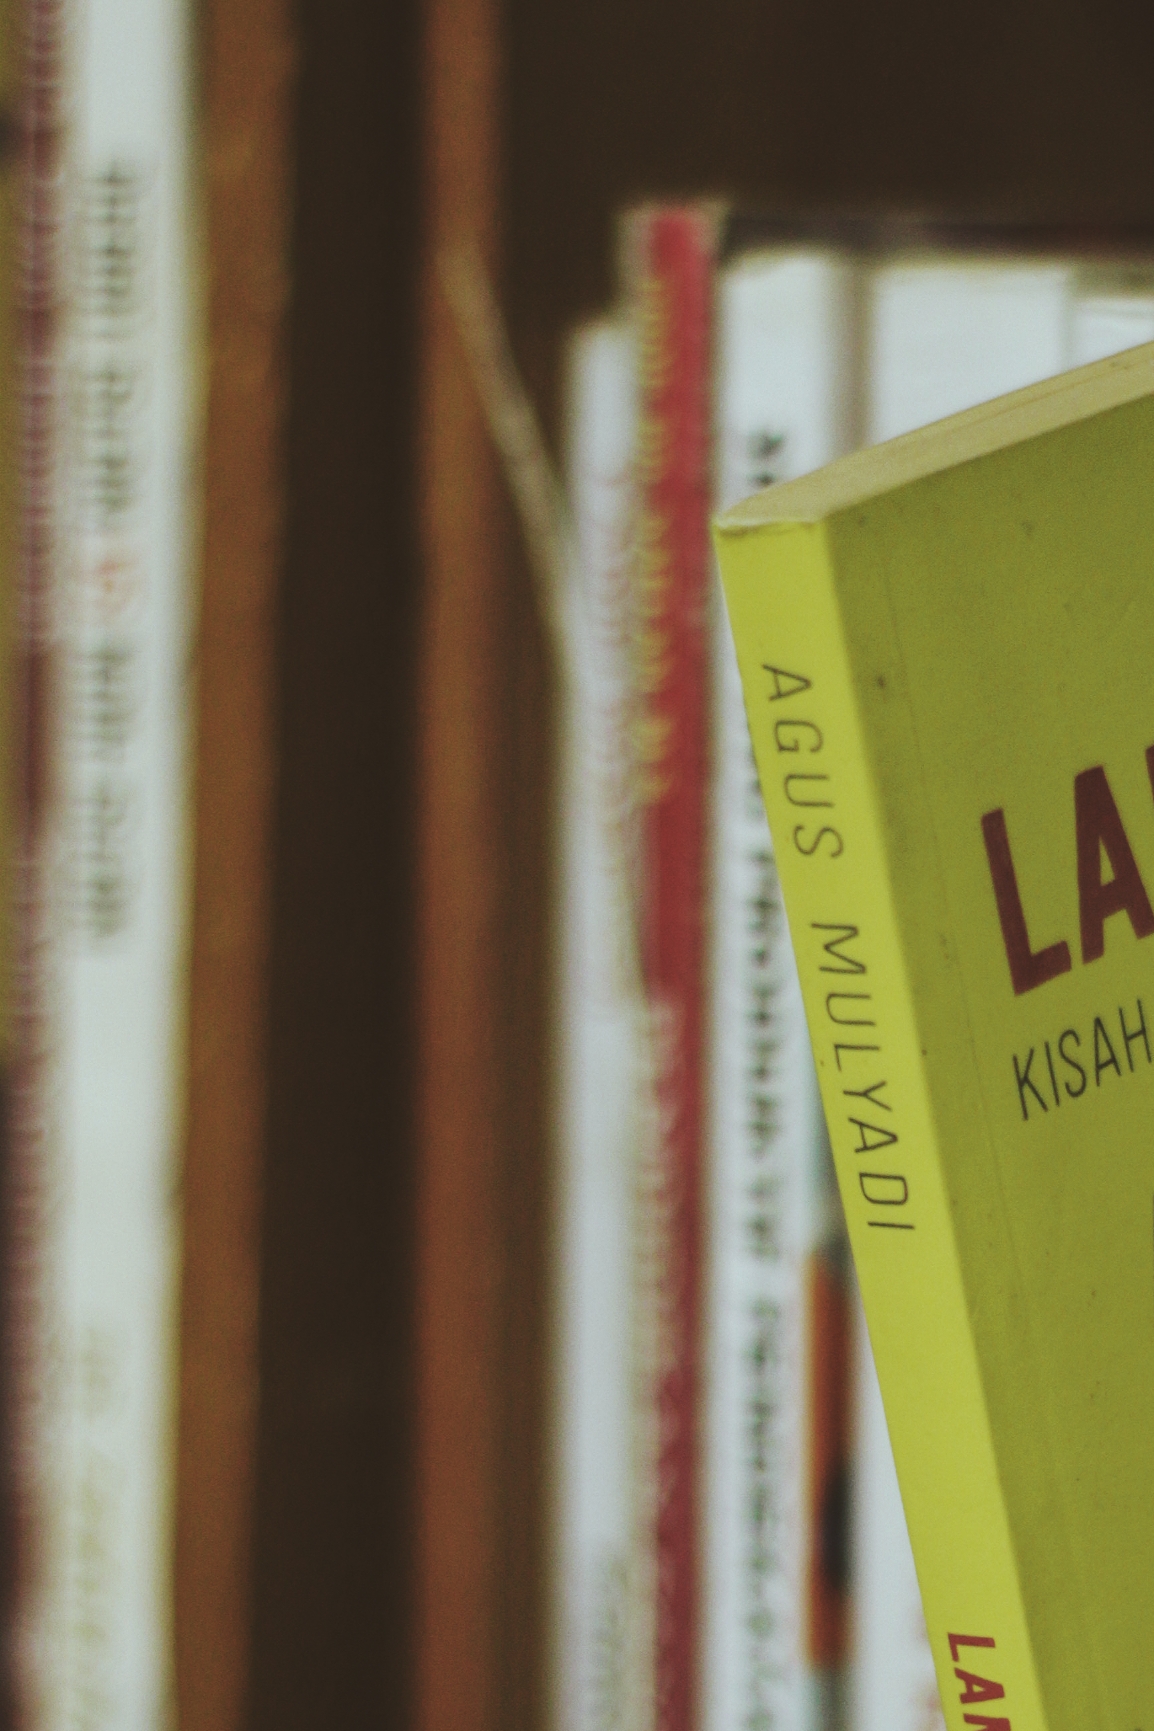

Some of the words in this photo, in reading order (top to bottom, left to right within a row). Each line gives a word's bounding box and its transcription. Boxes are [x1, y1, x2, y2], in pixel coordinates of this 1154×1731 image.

[761, 663, 845, 859] AGUS
[810, 921, 916, 1231] MULYADI
[1011, 998, 1154, 1123] KISAH
